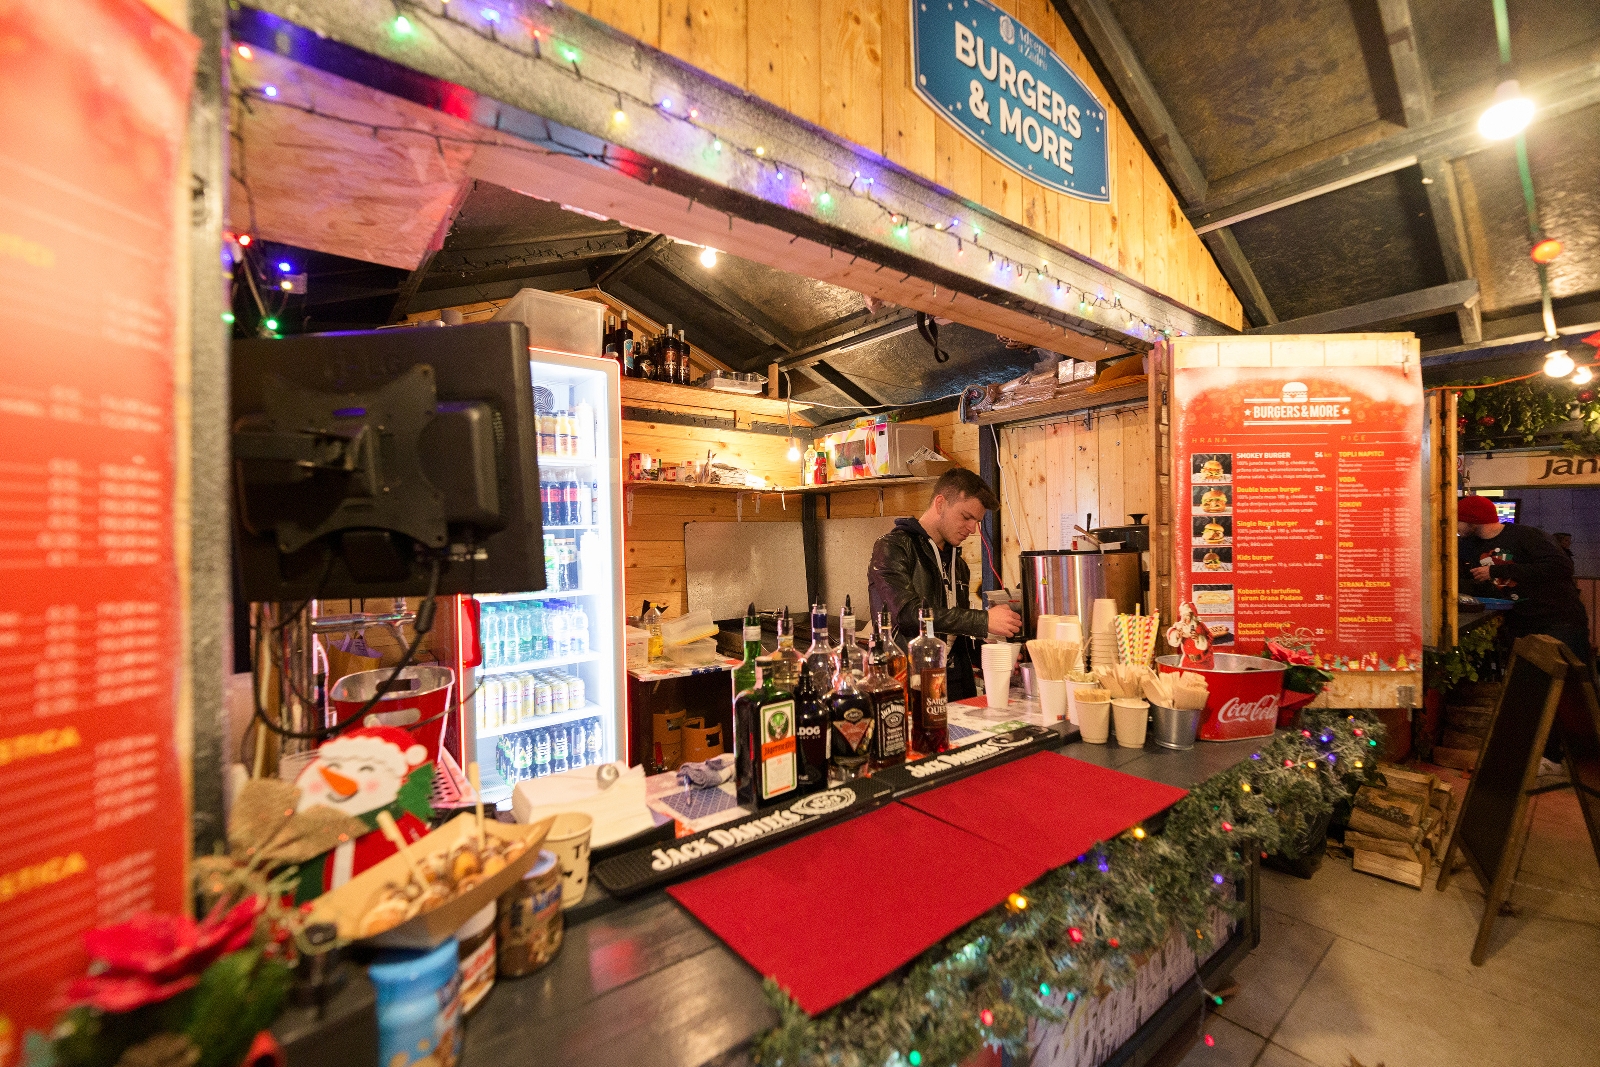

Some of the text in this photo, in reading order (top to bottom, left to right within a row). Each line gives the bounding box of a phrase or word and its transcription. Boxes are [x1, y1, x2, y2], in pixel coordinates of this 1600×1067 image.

[954, 20, 1082, 139] BURGERS
[969, 80, 1074, 174] & MORE
[905, 760, 952, 778] JACK
[652, 838, 718, 871] JACK
